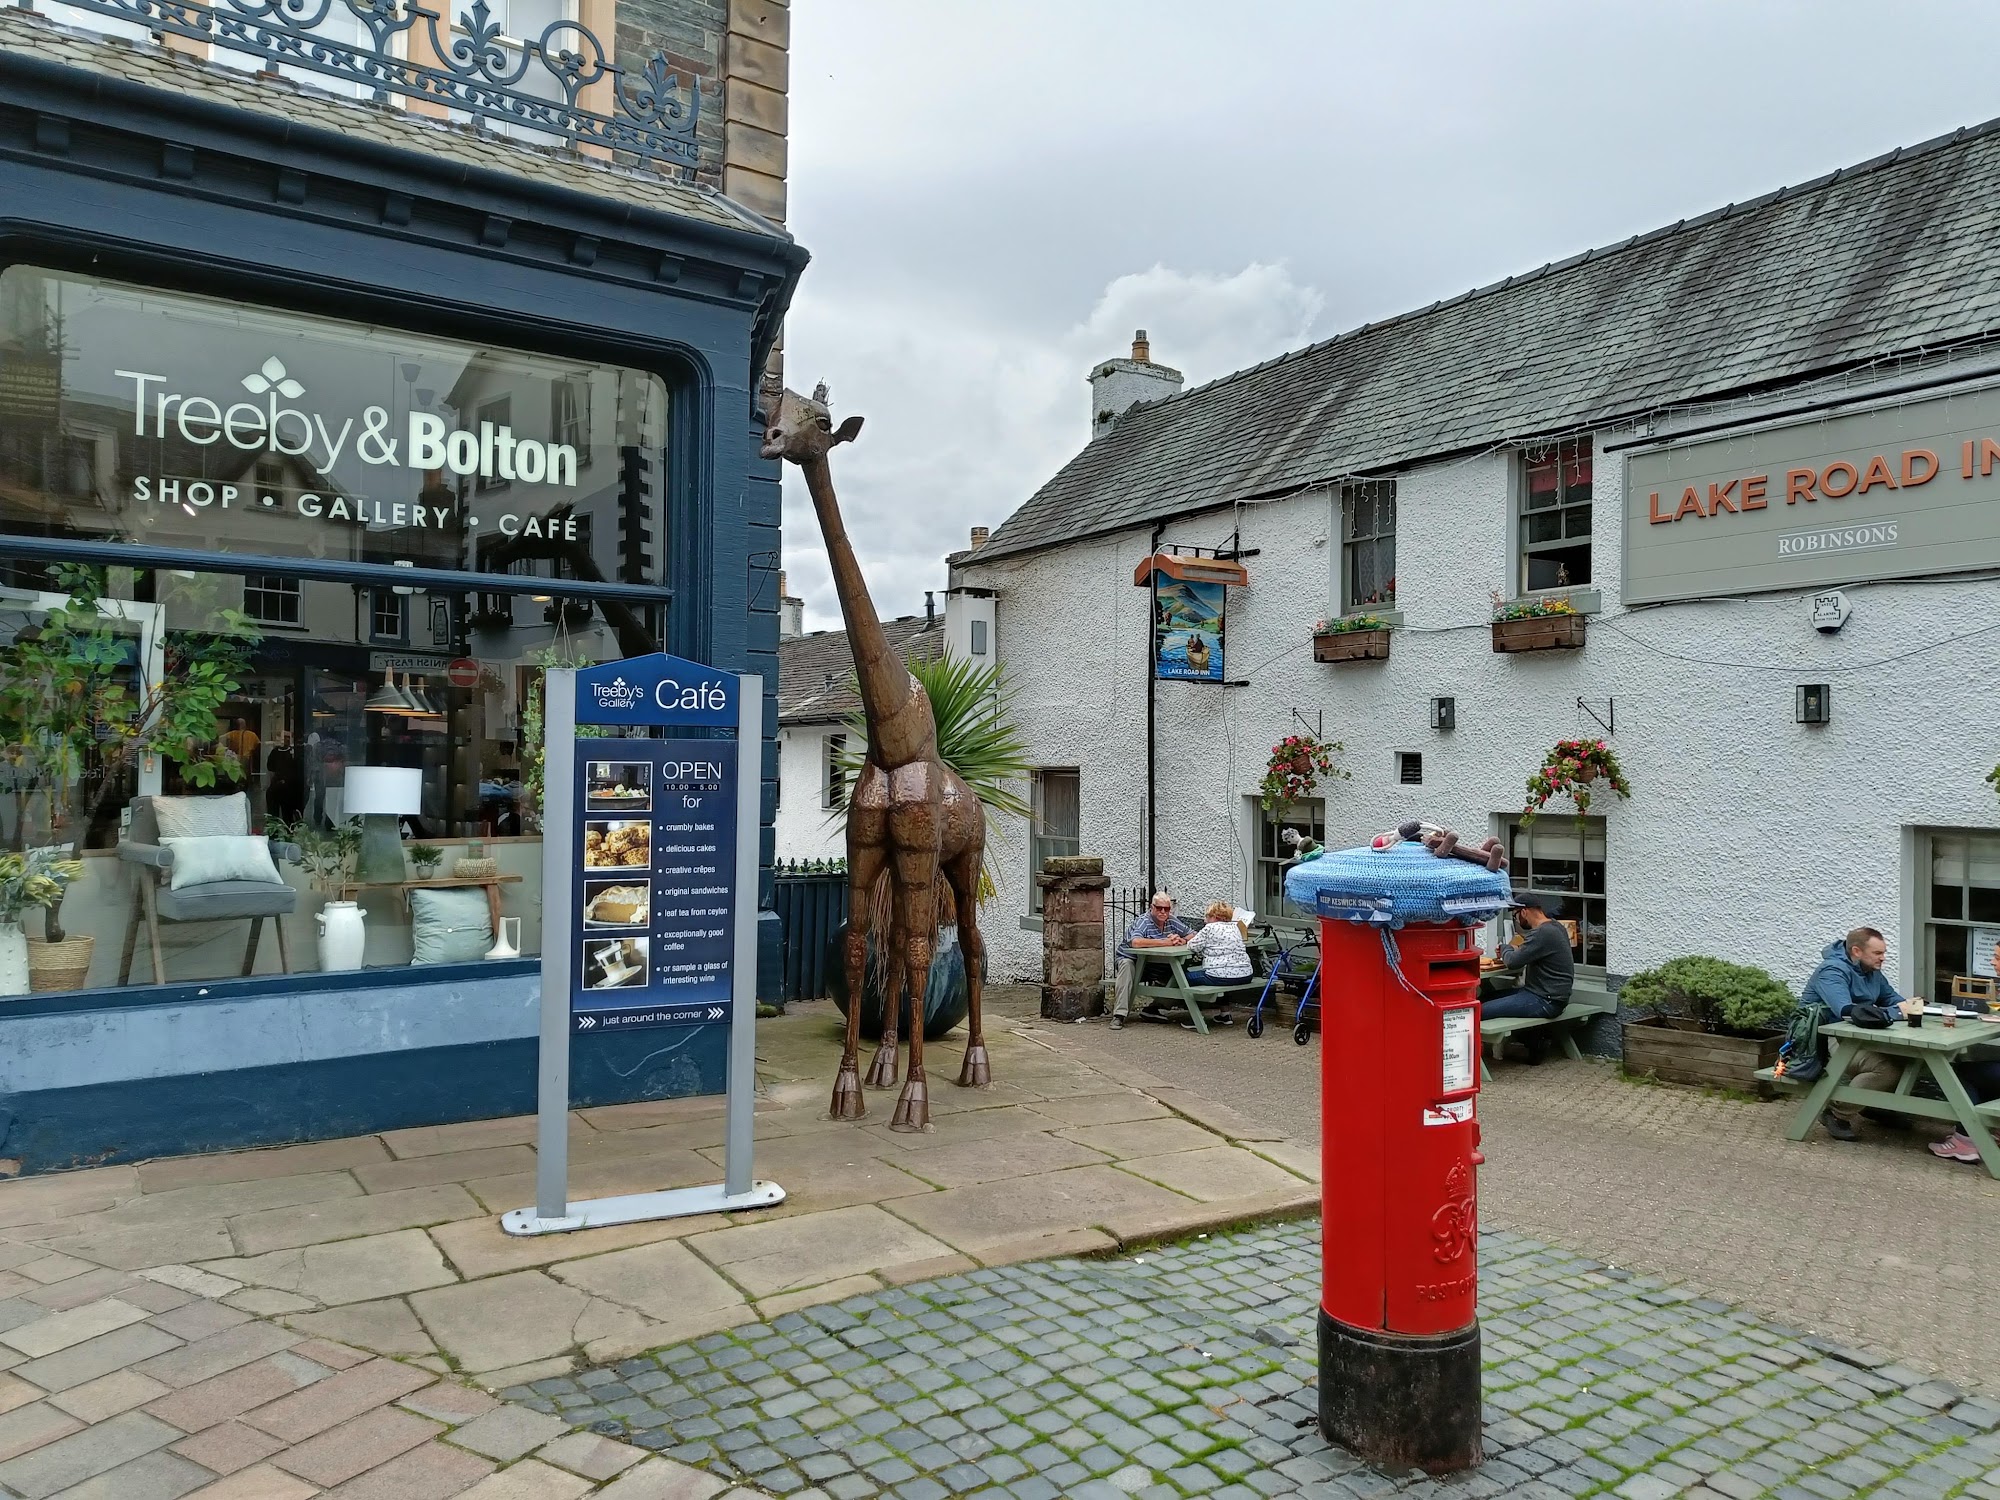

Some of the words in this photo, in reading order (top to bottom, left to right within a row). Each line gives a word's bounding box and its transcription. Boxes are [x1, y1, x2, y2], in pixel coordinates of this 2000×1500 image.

[114, 369, 354, 474] Treeby
[355, 405, 401, 467] &
[408, 410, 578, 487] Bolton
[1649, 474, 1768, 525] LAKE
[1785, 449, 1940, 505] ROAD
[133, 475, 238, 509] SHOP
[298, 493, 450, 529] GALLERY
[498, 513, 577, 542] CAFÉ
[1778, 524, 1898, 554] ROBINSONS
[590, 682, 644, 700] Treeby's
[655, 679, 726, 710] Café
[598, 698, 636, 710] Gallery
[662, 761, 722, 780] OPEN
[682, 794, 703, 809] for
[666, 822, 694, 833] crumbly
[694, 823, 715, 831] bakes
[665, 844, 695, 853] delicious
[696, 843, 716, 852] cakes
[665, 865, 692, 874] creative
[693, 864, 716, 875] crêpes
[665, 887, 690, 897] original
[690, 885, 729, 895] sandwiches
[1331, 897, 1357, 907] KESWICK
[664, 908, 678, 917] leaf
[678, 908, 690, 917] tea
[690, 907, 707, 916] from
[707, 906, 728, 917] ceylon
[664, 929, 707, 939] exceptionally
[708, 928, 724, 938] good
[663, 942, 685, 951] coffee
[663, 965, 671, 973] or
[671, 963, 696, 973] sample
[703, 961, 720, 972] glass
[721, 960, 729, 969] of
[663, 974, 698, 985] interesting
[699, 974, 716, 982] wine
[602, 1015, 620, 1027] just
[621, 1012, 655, 1024] around
[656, 1011, 671, 1022] the
[672, 1009, 703, 1020] corner
